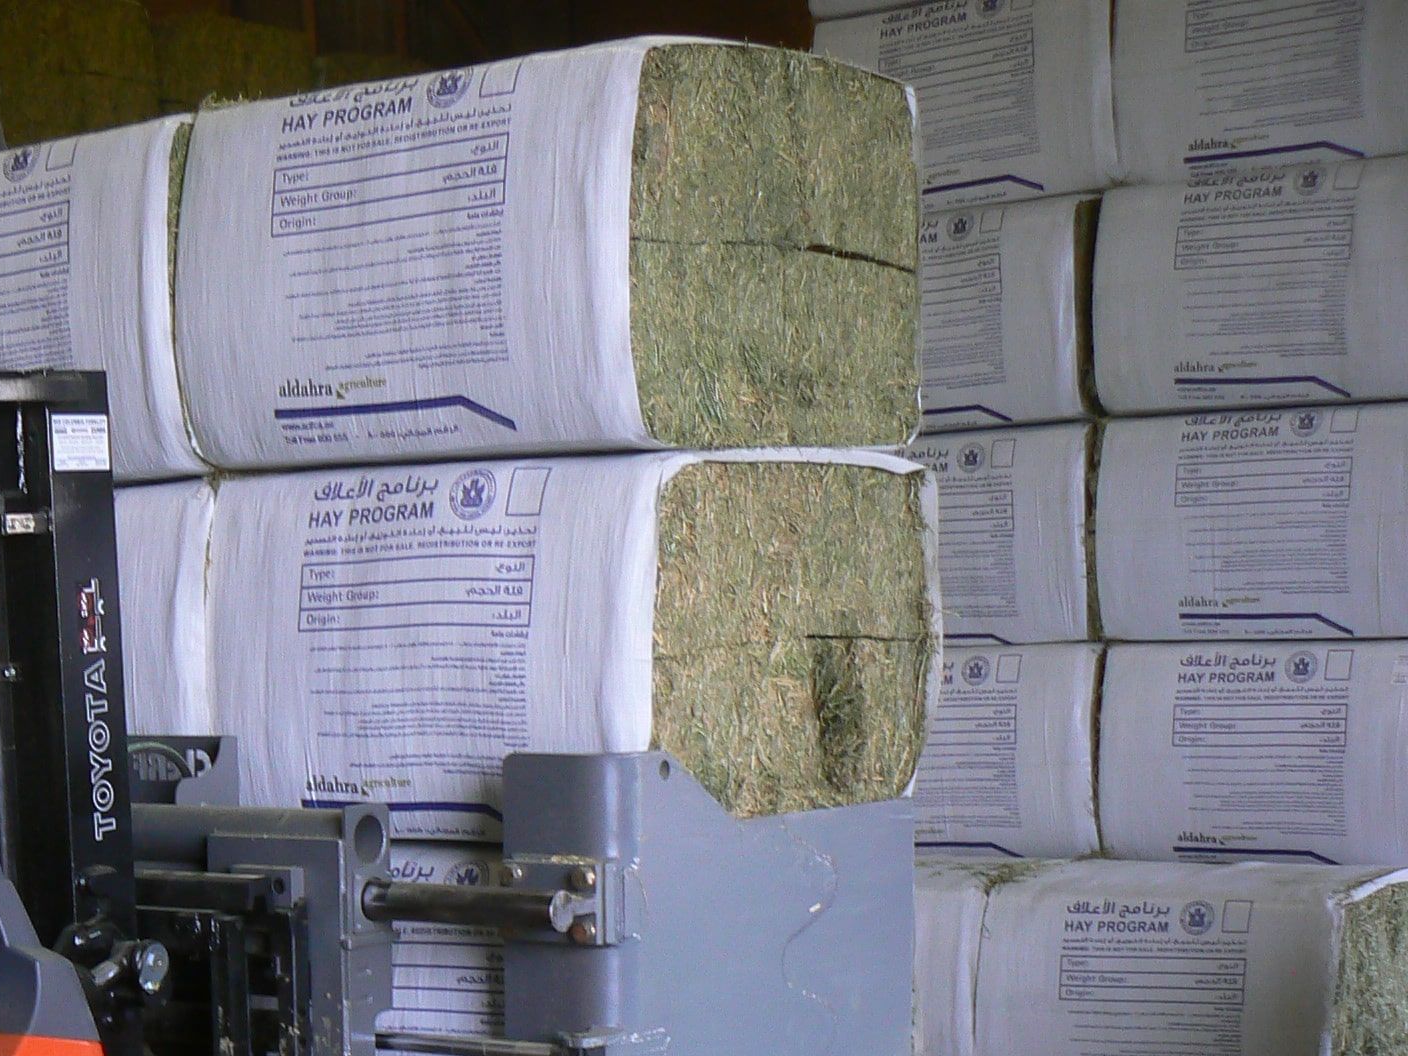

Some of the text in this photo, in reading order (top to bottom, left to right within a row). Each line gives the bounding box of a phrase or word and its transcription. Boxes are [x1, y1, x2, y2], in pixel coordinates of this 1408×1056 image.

[880, 26, 903, 39] HAY
[907, 12, 967, 33] PROGRAM
[282, 96, 413, 134] HAY PROGRAM
[280, 192, 318, 208] Weight
[1184, 186, 1283, 205] HAY PROGRAM
[1174, 361, 1214, 373] aldahra
[279, 378, 333, 398] aldahra
[1181, 426, 1279, 442] HAY PROGRAM
[314, 475, 439, 502] برنامج الأعلاف
[308, 501, 434, 528] HAY PROGRAM
[309, 569, 335, 581] Type:
[307, 590, 379, 604] Weight Group:
[1178, 596, 1219, 608] aldahra
[306, 613, 340, 626] Origin:
[1180, 652, 1276, 670] برنامج الأعلاف
[1177, 672, 1275, 684] HAY PROGRAM
[83, 657, 117, 841] TOYOTA
[306, 774, 359, 794] aldahra
[1177, 831, 1217, 843] aldahra
[1067, 899, 1170, 918] برنامج الأعلاف
[1064, 920, 1169, 933] HAY PROGRAM
